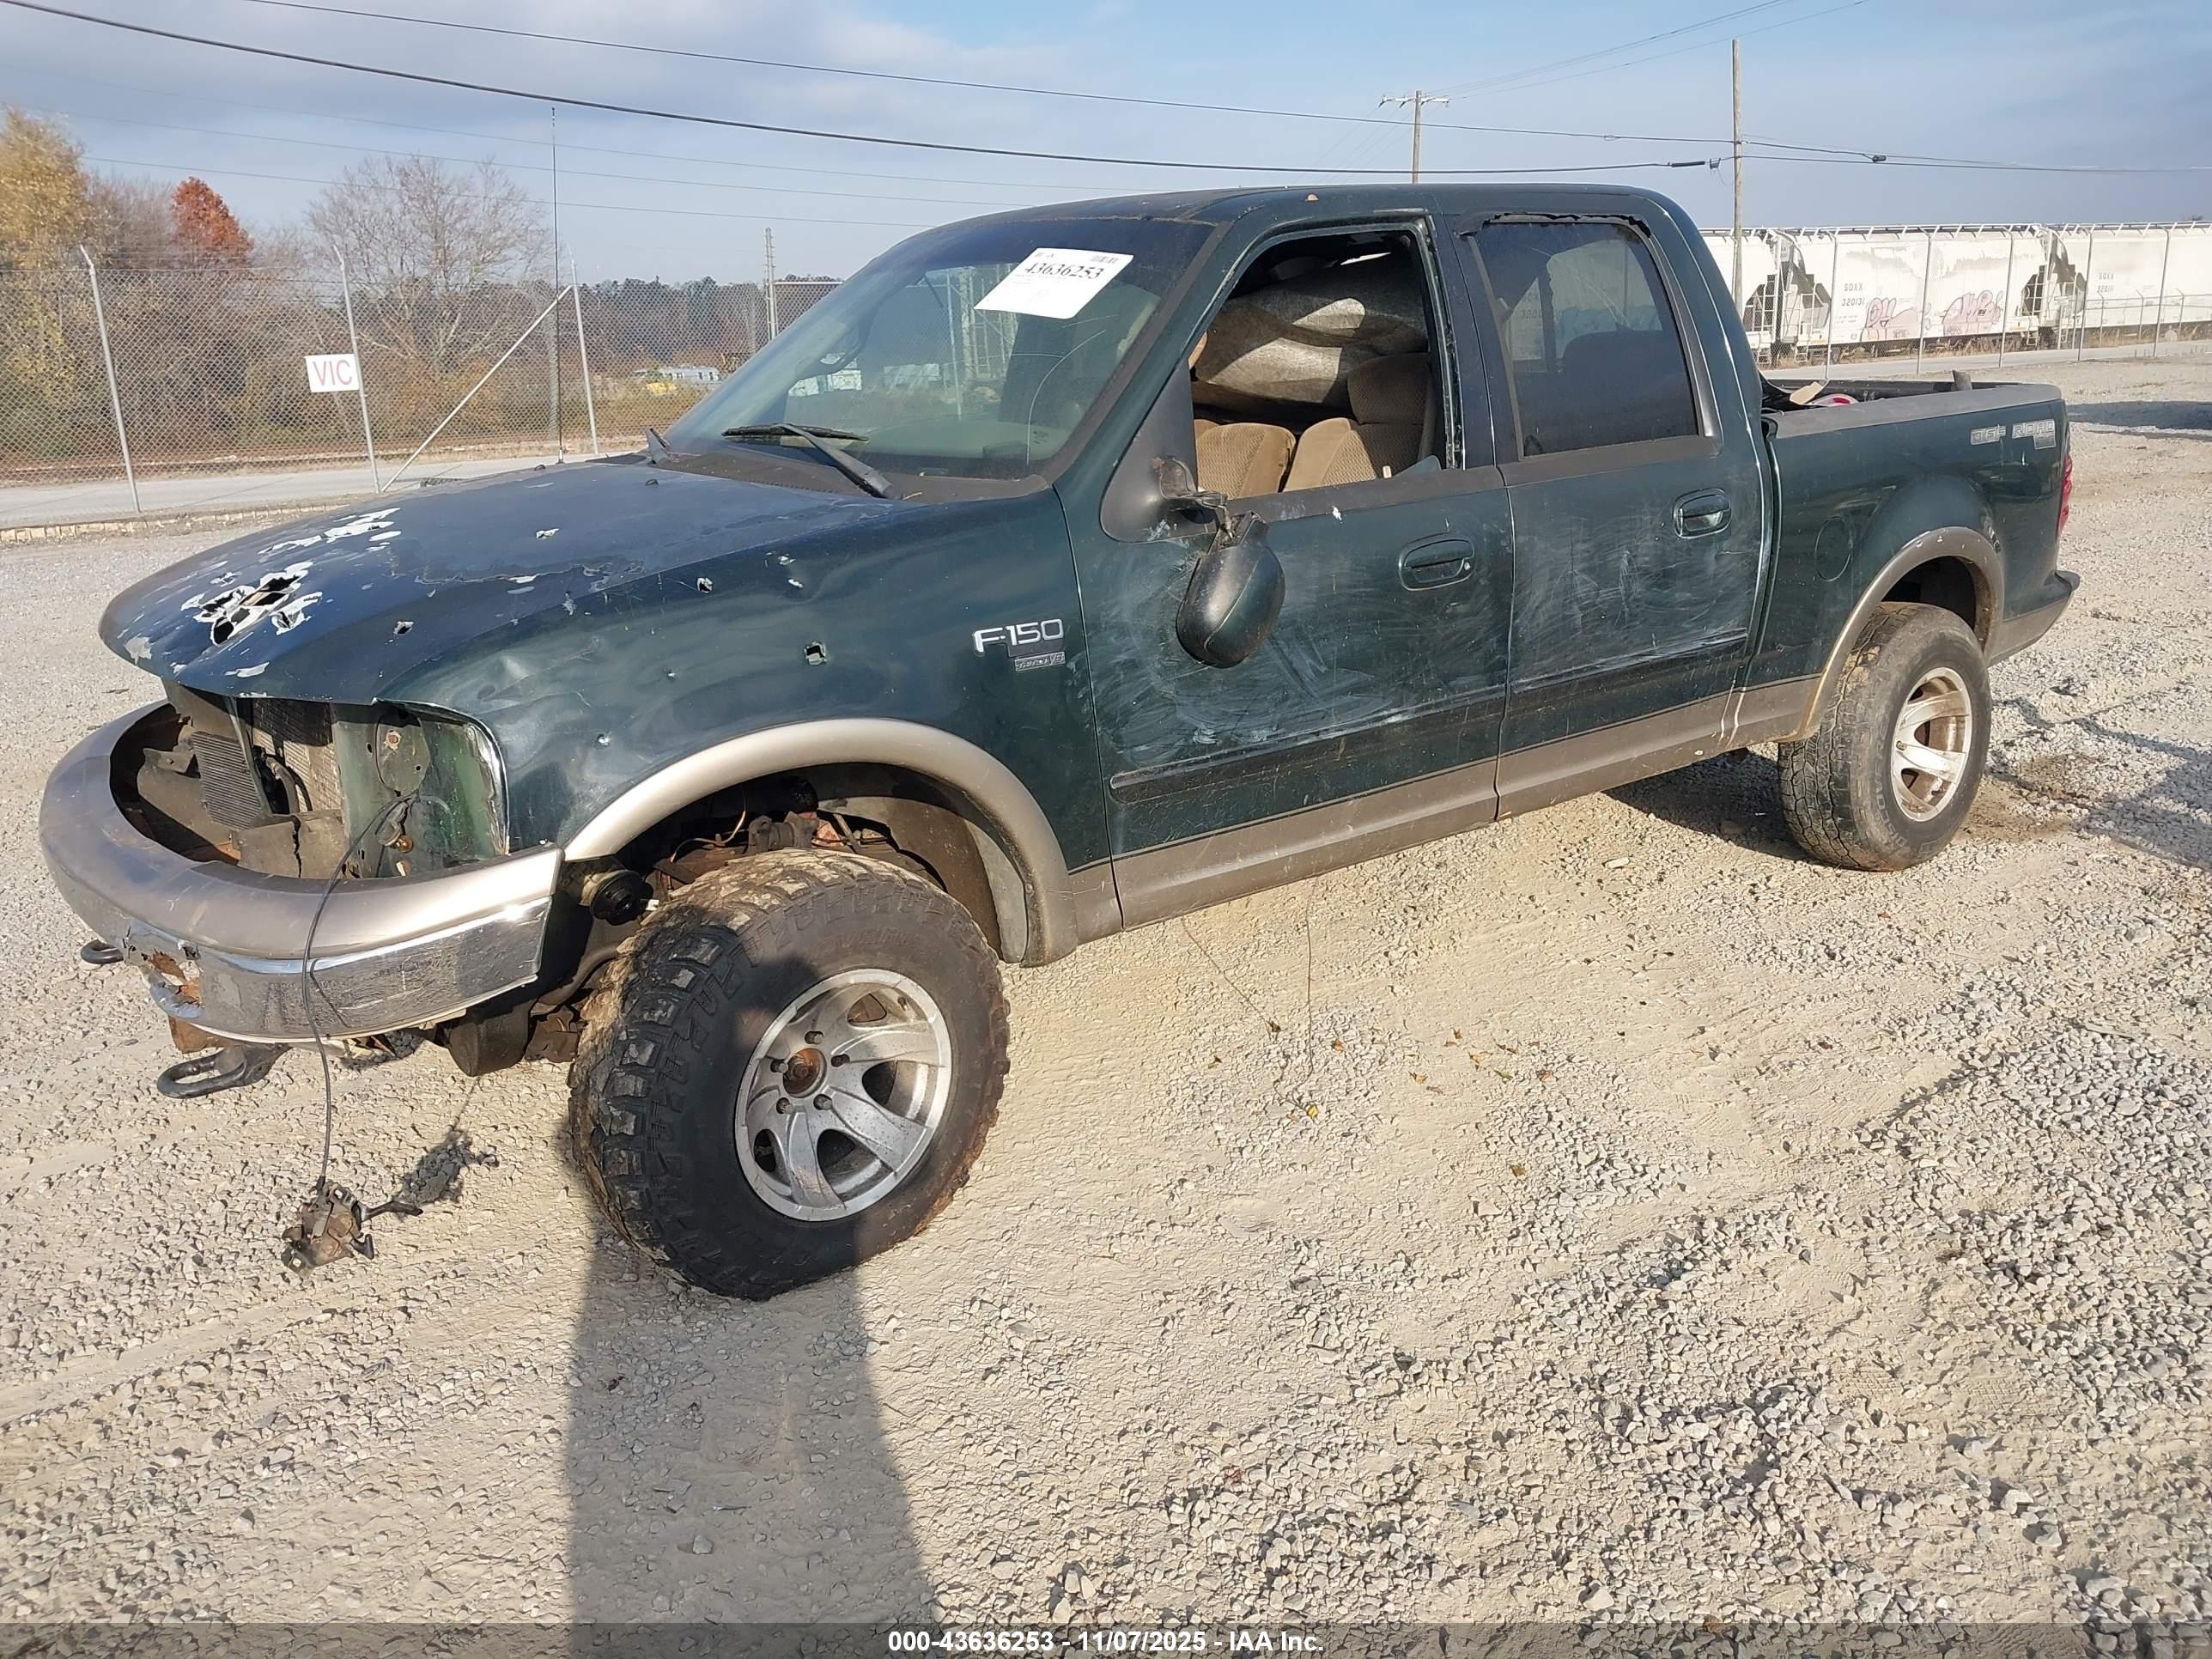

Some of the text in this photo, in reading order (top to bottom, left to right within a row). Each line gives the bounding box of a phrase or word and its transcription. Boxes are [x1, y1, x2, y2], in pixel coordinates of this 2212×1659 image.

[1024, 262, 1104, 279] 43636253
[1844, 282, 1863, 292] SOXX
[313, 359, 353, 386] VIC
[2012, 419, 2055, 438] ROAD
